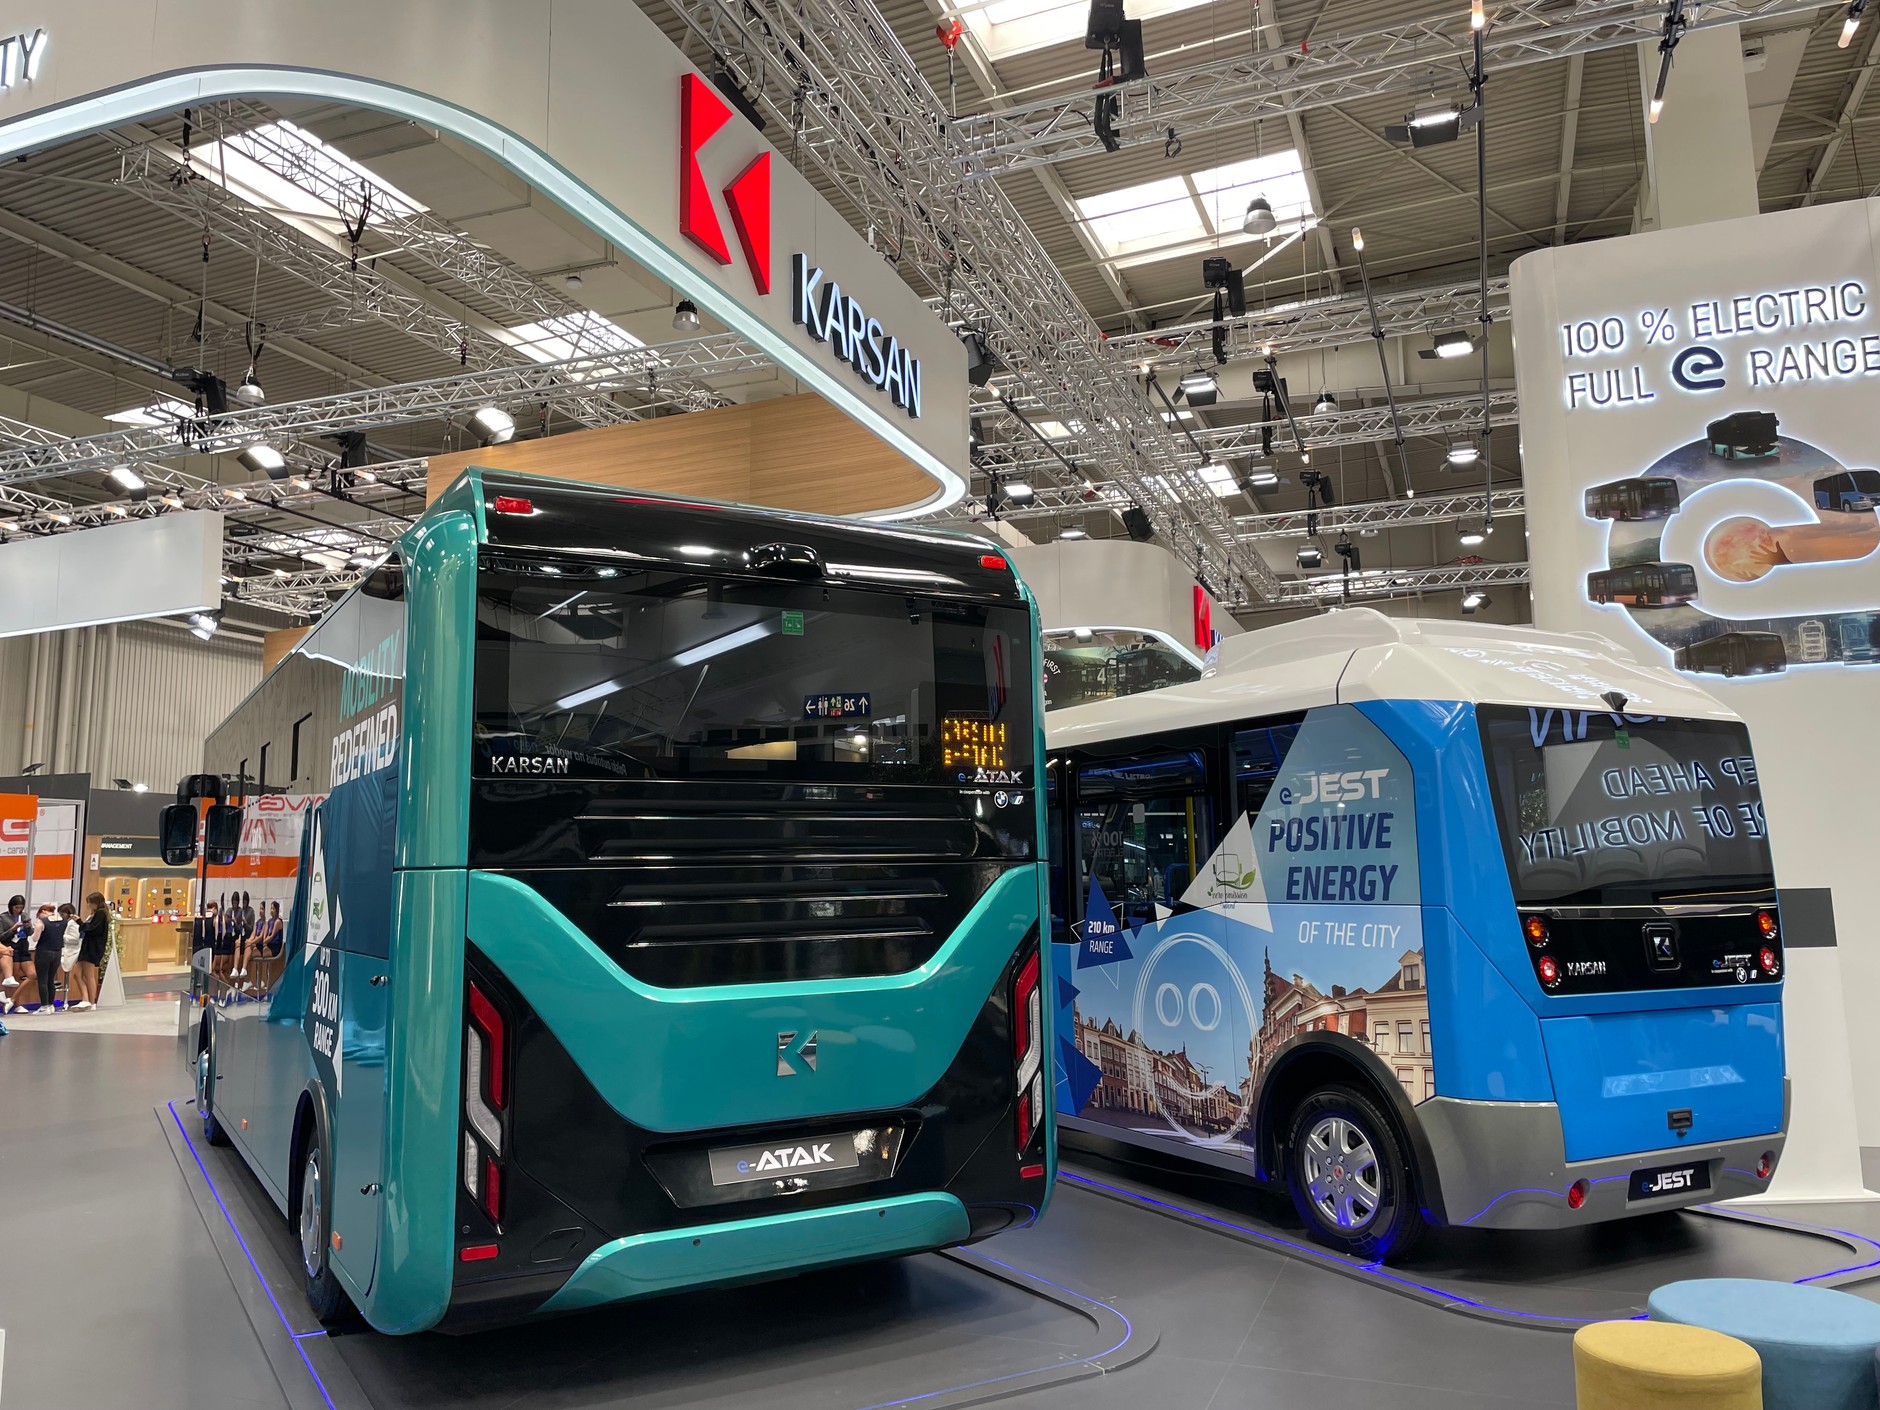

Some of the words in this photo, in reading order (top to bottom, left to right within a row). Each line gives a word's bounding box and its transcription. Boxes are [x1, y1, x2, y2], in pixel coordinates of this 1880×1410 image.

[793, 252, 920, 418] KARSAN
[1563, 317, 1624, 356] 100
[1641, 308, 1675, 345] %
[1691, 282, 1866, 338] ELECTRIC
[1568, 366, 1655, 408] FULL
[1750, 335, 1880, 386] RANGE
[339, 628, 400, 724] MOBILITY
[1043, 658, 1061, 675] FIRST
[1097, 667, 1106, 685] 4
[330, 704, 398, 788] REDEFINED
[491, 756, 569, 774] KARSAN
[957, 766, 1024, 784] e-ATAK
[1269, 812, 1394, 853] POSITIVE
[1286, 864, 1399, 901] ENERGY
[1088, 921, 1101, 934] 210
[1102, 921, 1115, 934] km
[1299, 920, 1321, 944] OF
[1324, 922, 1356, 946] THE
[1362, 923, 1401, 949] CITY
[1089, 940, 1114, 954] RANGE
[1567, 961, 1607, 977] KARSAN
[312, 969, 331, 1019] 300
[328, 993, 339, 1022] KM
[313, 1021, 334, 1058] RANGE
[736, 1142, 835, 1174] e-ATAK
[1641, 1168, 1695, 1193] e-JEST
